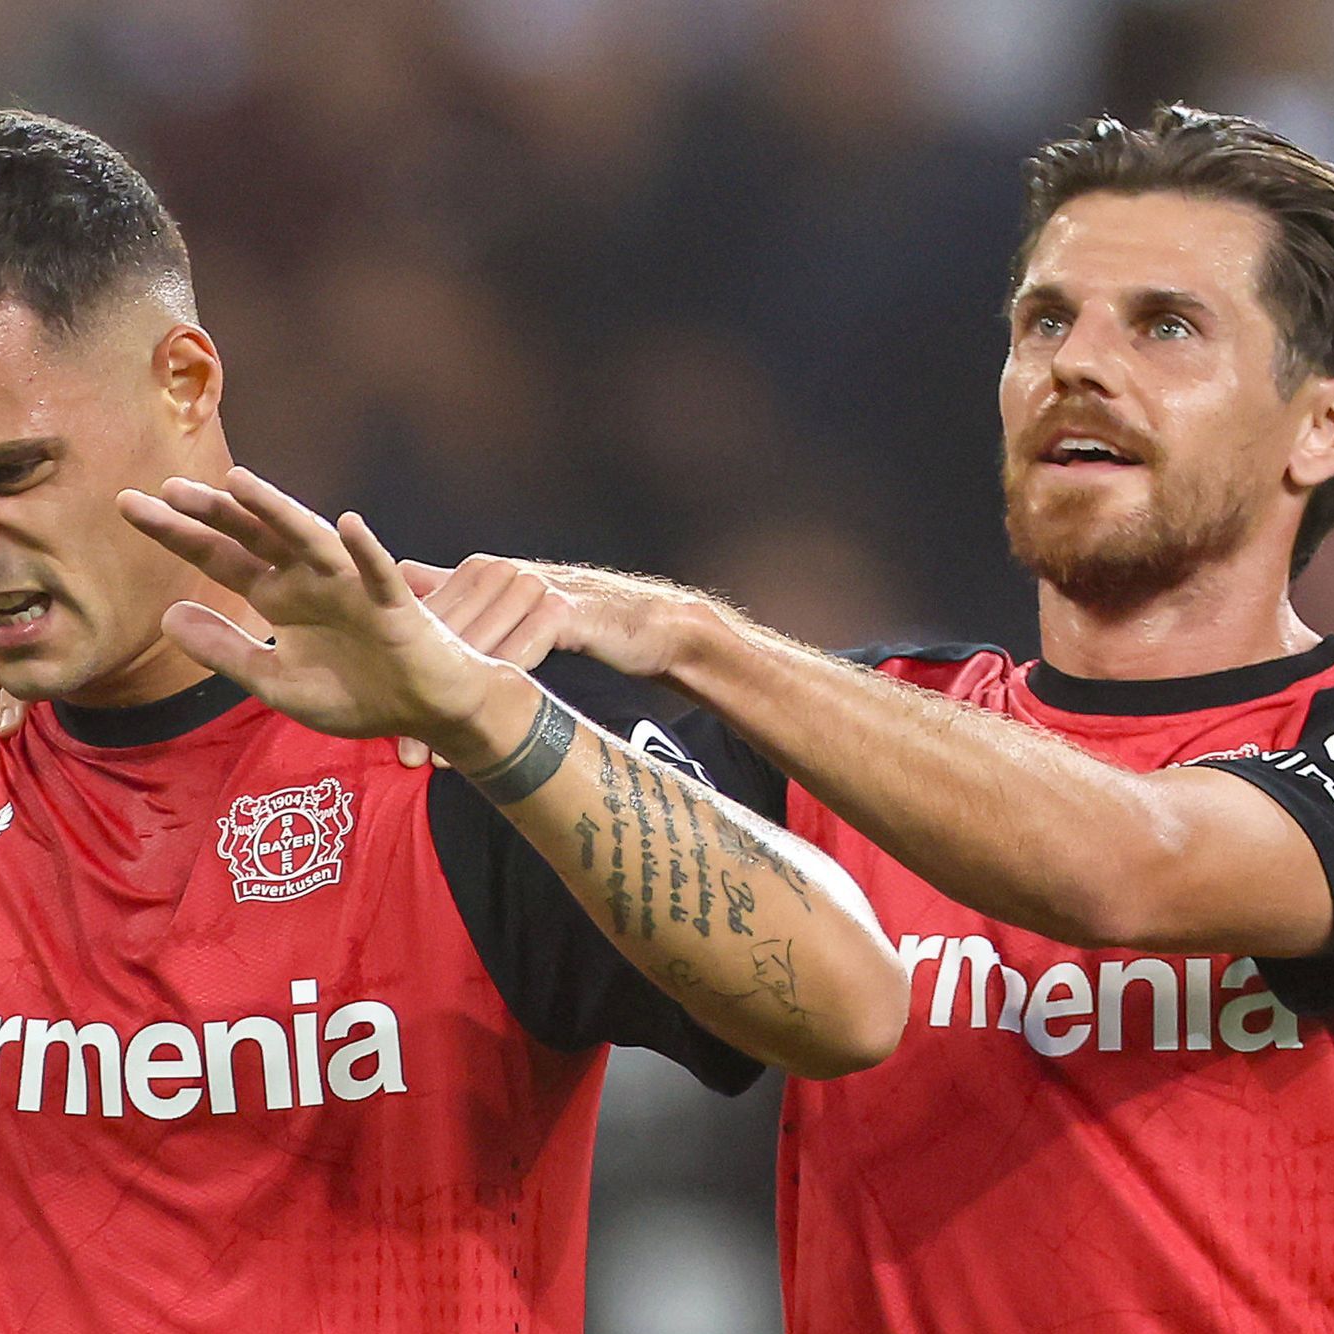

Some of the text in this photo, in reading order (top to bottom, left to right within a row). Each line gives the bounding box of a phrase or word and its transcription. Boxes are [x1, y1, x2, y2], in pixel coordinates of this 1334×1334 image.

[270, 793, 302, 810] 1904
[259, 833, 314, 855] BAYER
[280, 814, 294, 874] BAYER
[242, 867, 332, 896] Leverkusen
[898, 933, 1305, 1057] rmenia
